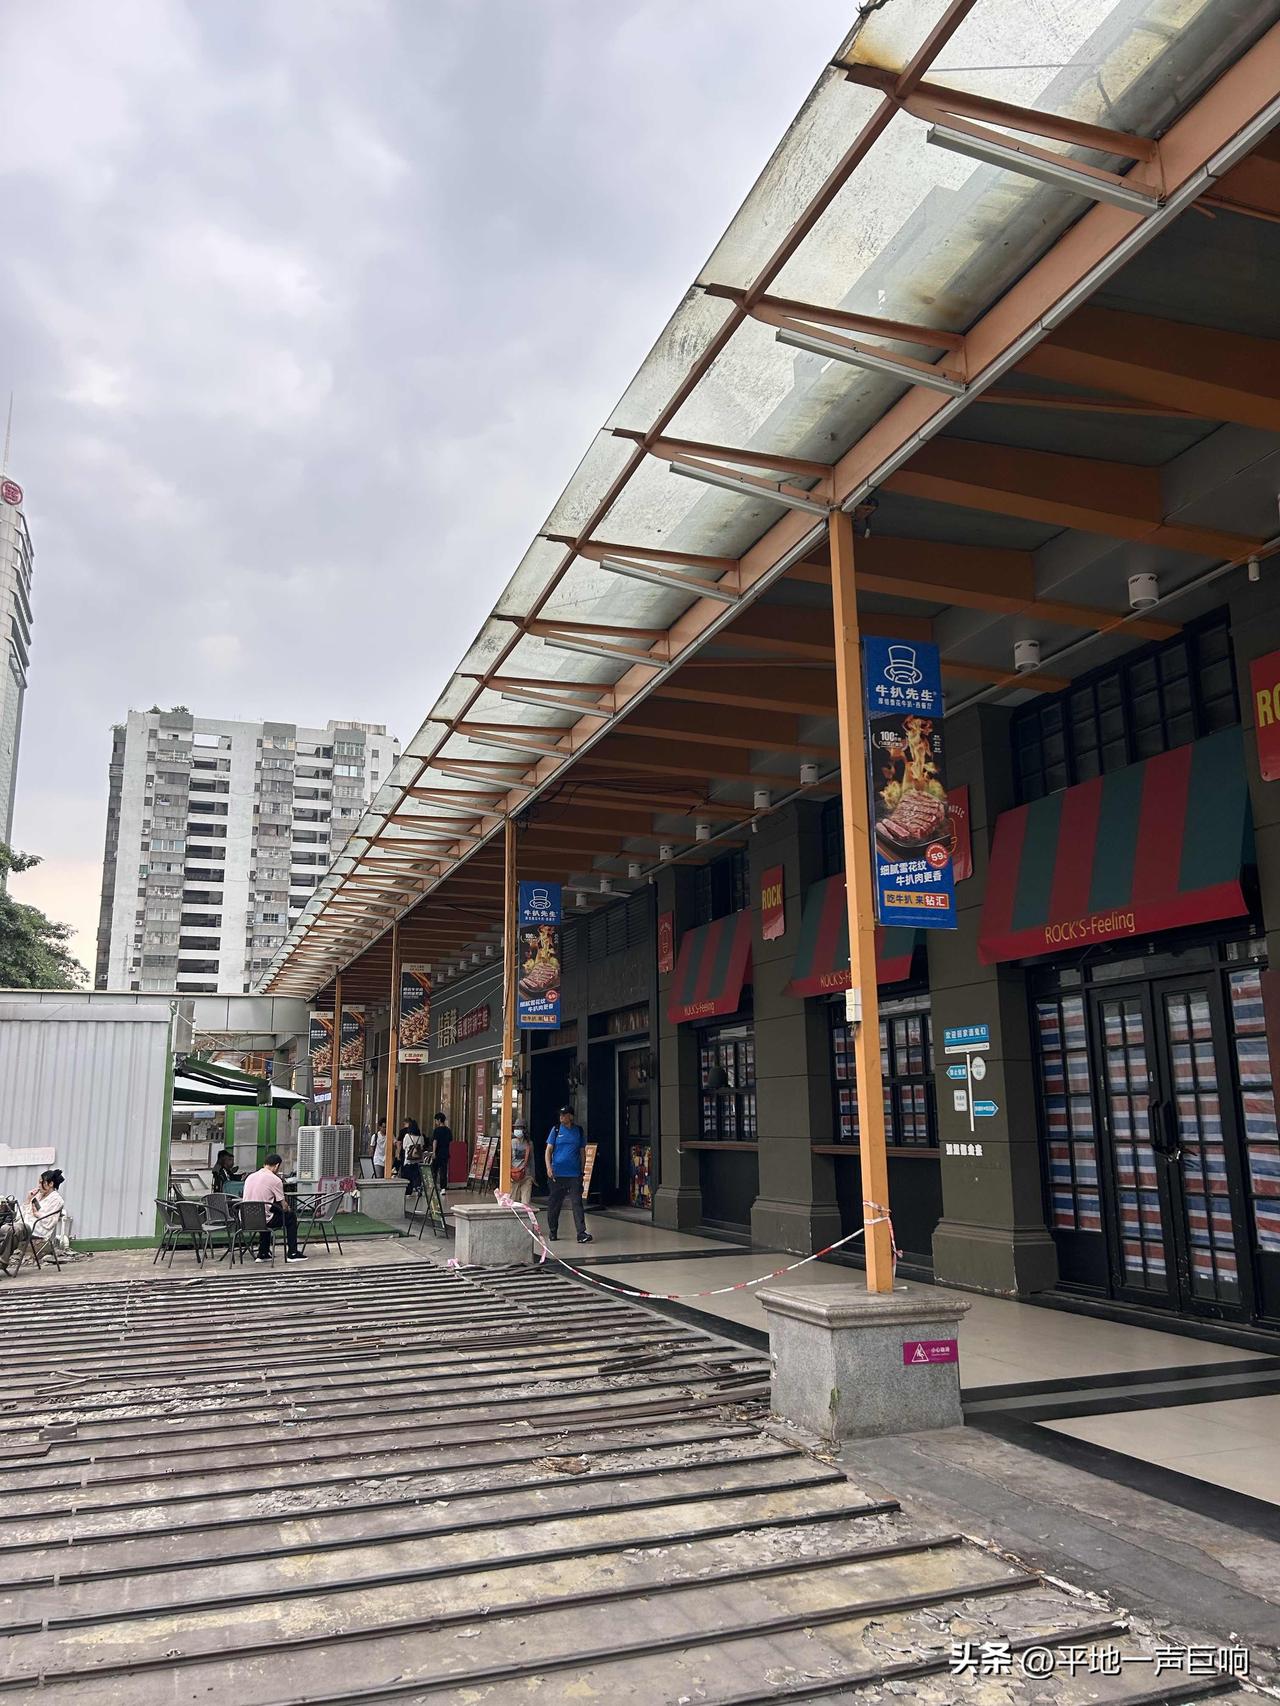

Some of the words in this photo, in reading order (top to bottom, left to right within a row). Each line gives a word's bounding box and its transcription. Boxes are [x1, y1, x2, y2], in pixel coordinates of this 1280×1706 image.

[876, 684, 934, 702] 牛扒先生
[931, 852, 944, 861] 59
[880, 860, 927, 876] 细腻雪花纹
[896, 870, 942, 886] 牛扒肉更香
[761, 883, 782, 910] ROCK
[1045, 911, 1136, 944] ROCK'S-Feeling
